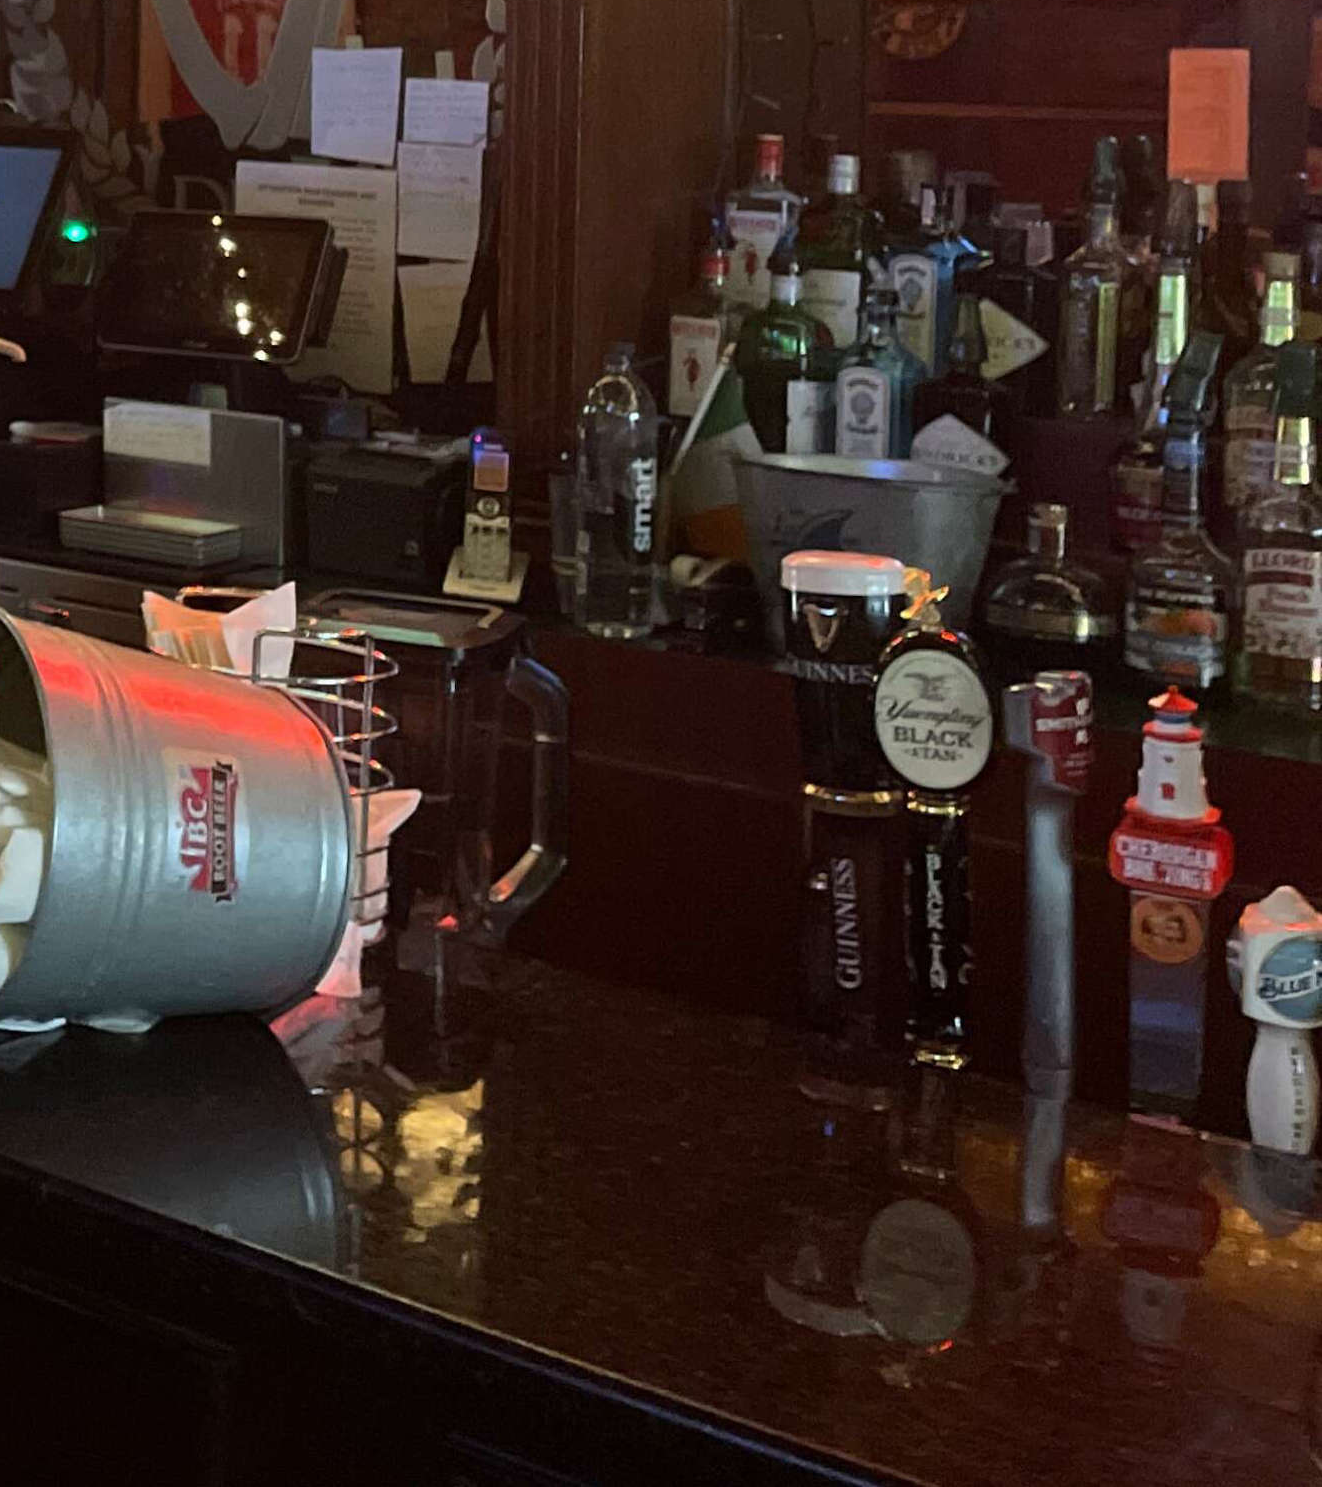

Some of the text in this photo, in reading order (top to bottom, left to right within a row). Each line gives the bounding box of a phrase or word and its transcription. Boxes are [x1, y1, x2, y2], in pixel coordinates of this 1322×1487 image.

[631, 457, 654, 553] smart
[776, 656, 873, 685] GUINNES
[892, 726, 974, 749] BLACK
[179, 797, 208, 857] IBC
[212, 779, 227, 882] ROOT BEER
[831, 858, 863, 990] GUINNESS
[1259, 975, 1309, 1000] BLUE
